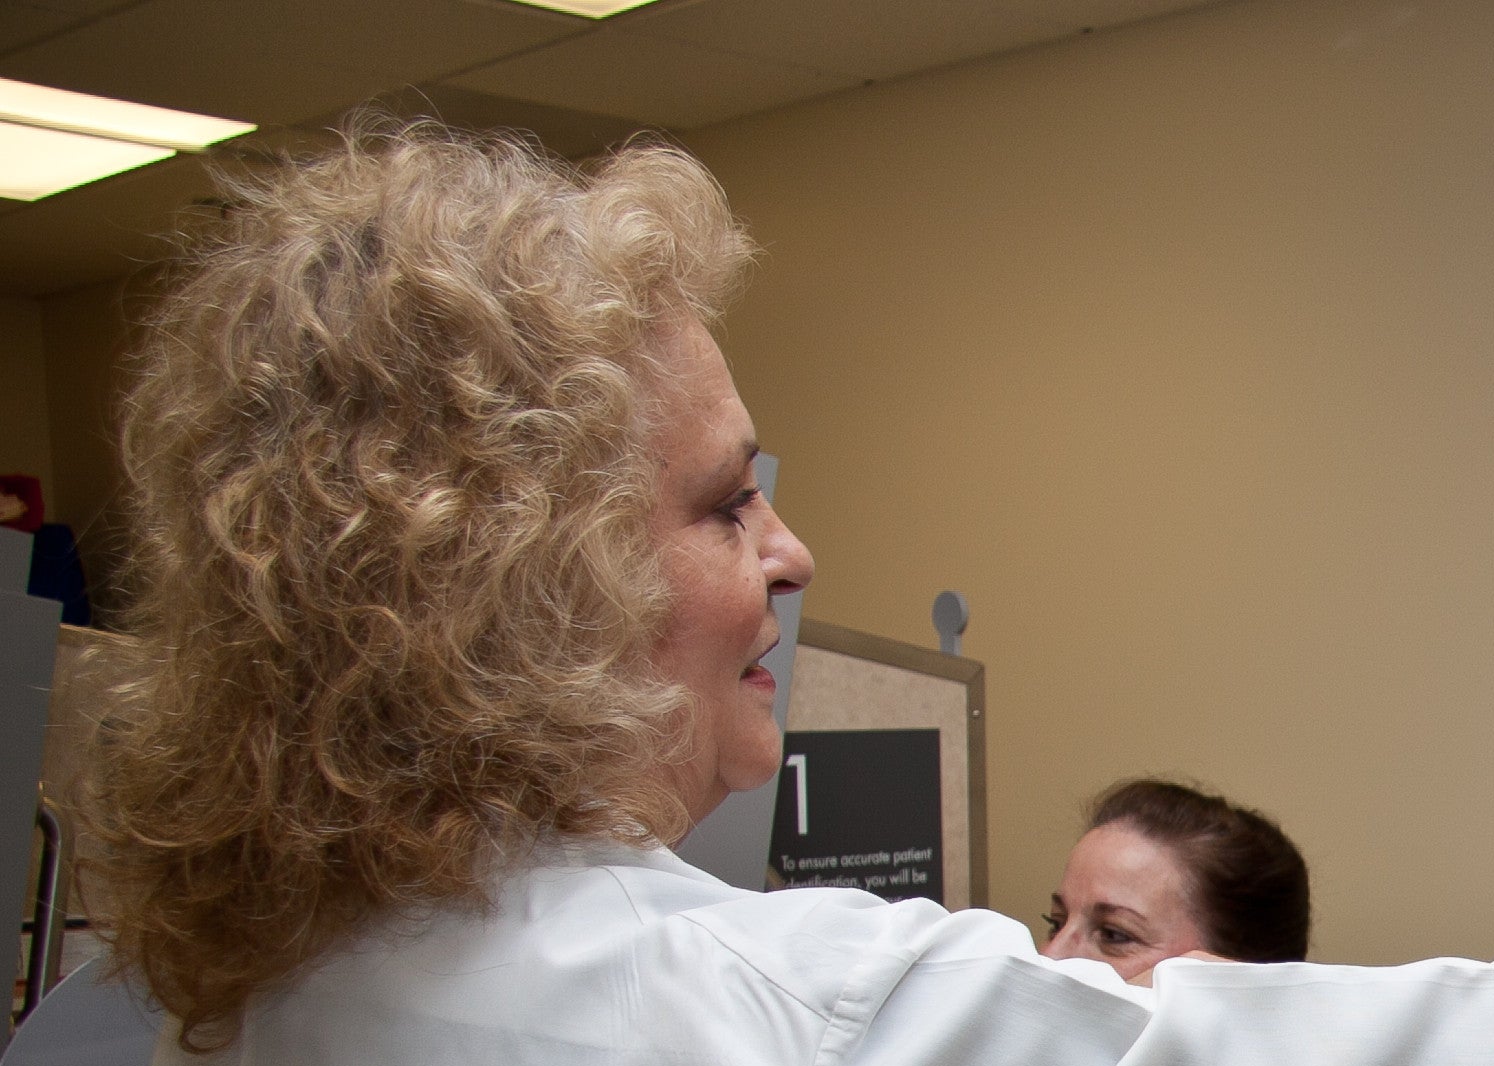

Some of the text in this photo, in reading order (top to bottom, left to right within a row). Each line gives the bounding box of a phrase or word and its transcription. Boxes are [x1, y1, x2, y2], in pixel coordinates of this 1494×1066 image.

[786, 754, 807, 835] 1
[781, 847, 933, 871] To ensure accurate patient
[865, 875, 887, 890] you
[889, 869, 908, 886] will
[912, 868, 927, 884] be
